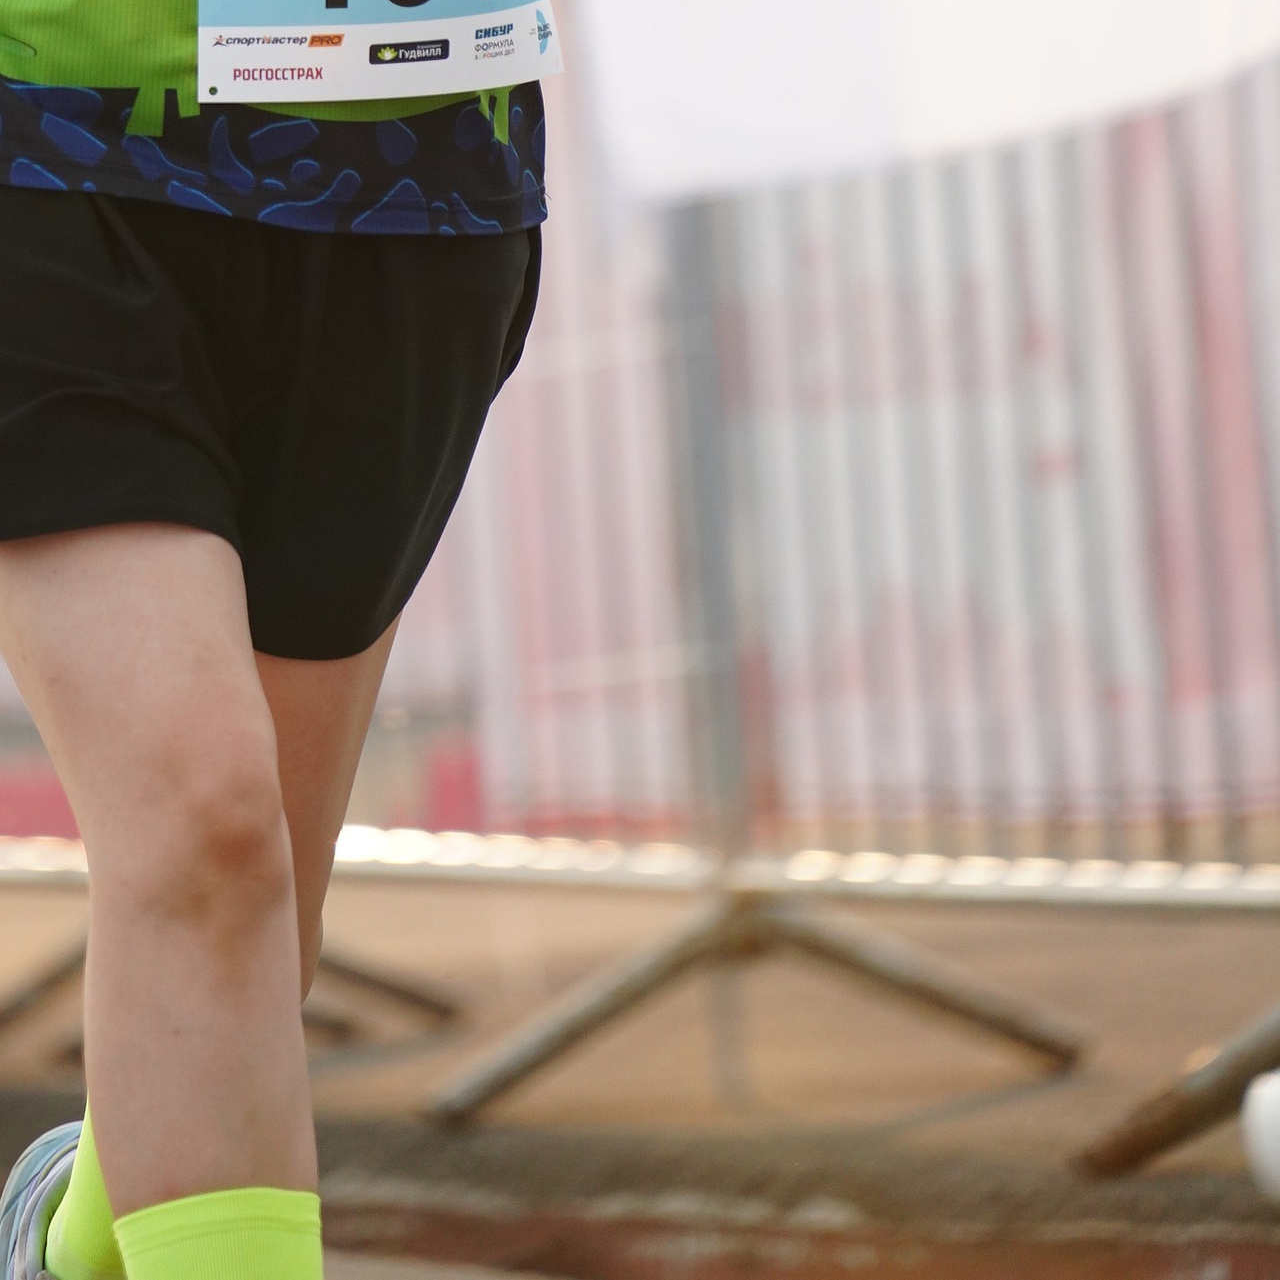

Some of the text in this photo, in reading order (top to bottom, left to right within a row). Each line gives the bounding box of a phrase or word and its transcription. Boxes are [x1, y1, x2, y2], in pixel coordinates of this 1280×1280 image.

[475, 23, 514, 39] СИБУР
[310, 34, 342, 45] PRO
[474, 38, 515, 52] ФОРМУЛА
[399, 47, 442, 60] Гудвилл
[233, 67, 323, 81] РОСГОССТРАХ
